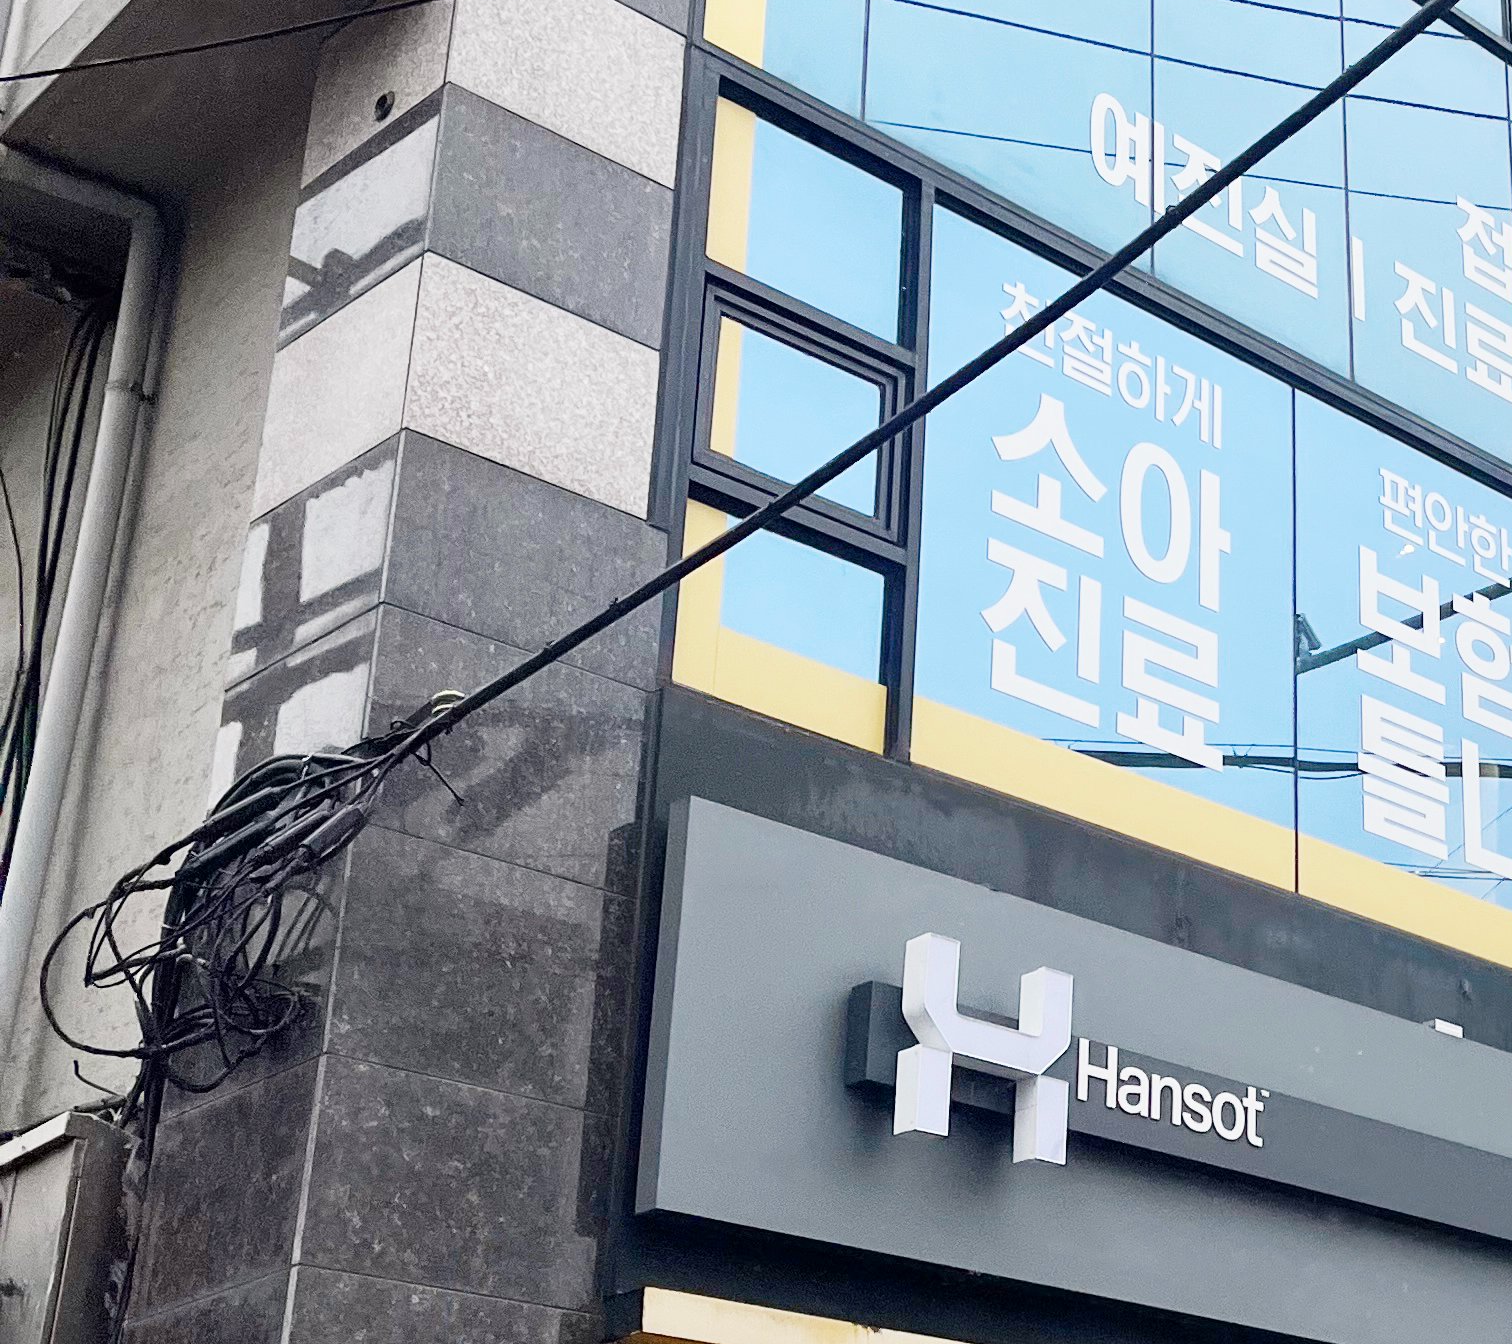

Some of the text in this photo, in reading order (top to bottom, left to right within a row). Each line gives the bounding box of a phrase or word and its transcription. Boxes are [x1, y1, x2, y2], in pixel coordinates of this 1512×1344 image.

[1089, 92, 1319, 299] 예진실
[1000, 281, 1223, 451] 친절하게
[991, 393, 1231, 613] 소아
[1378, 466, 1512, 589] 편안한
[981, 536, 1225, 774] 진료
[1076, 1036, 1272, 1148] Hansot
